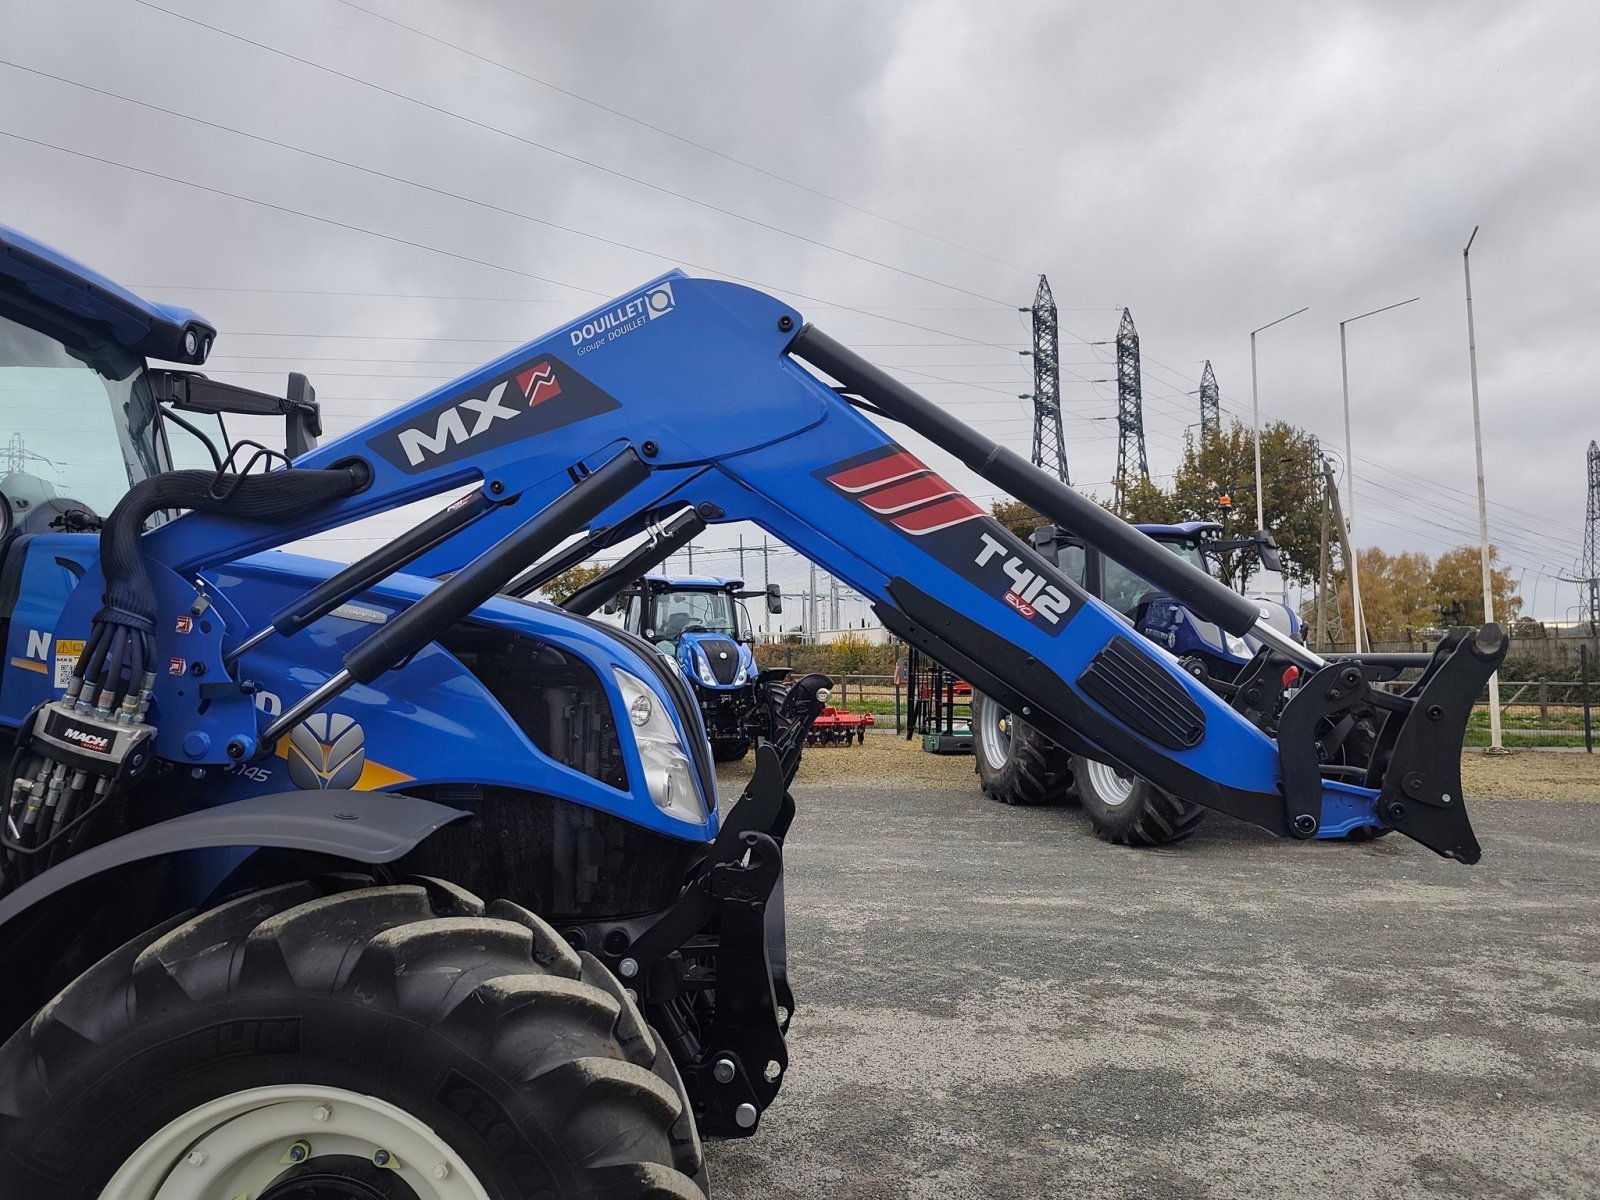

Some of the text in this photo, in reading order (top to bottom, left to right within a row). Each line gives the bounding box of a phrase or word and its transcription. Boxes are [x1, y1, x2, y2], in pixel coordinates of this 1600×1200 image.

[570, 297, 644, 346] DOUILLET
[576, 315, 646, 356] Groupe DOUILLET
[397, 380, 523, 467] MX
[1005, 593, 1035, 616] EVO
[64, 728, 109, 747] MACH
